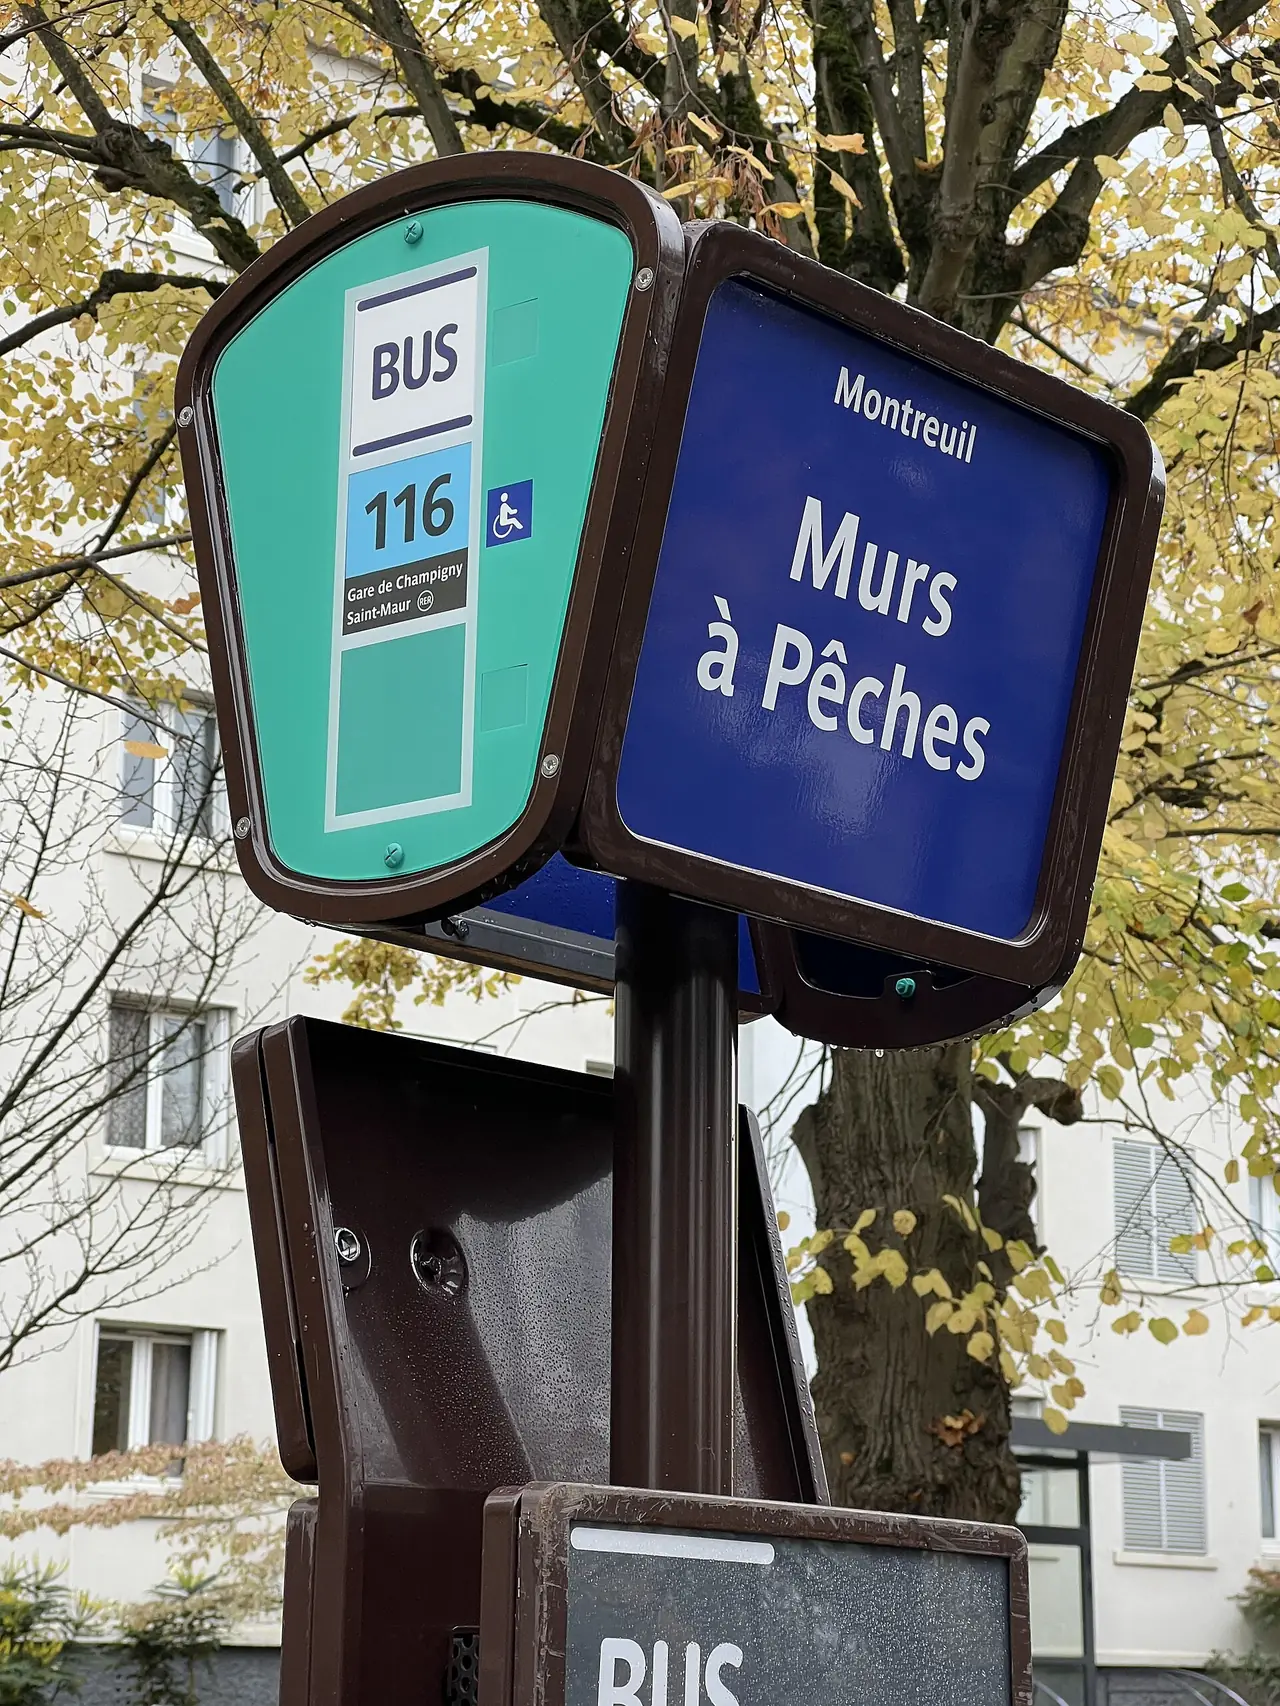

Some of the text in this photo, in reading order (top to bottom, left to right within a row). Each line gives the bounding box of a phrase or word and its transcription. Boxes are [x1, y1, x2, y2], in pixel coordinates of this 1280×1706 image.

[372, 323, 458, 400] BUS
[834, 366, 977, 463] Montreuil
[365, 473, 454, 550] 116
[347, 562, 463, 602] Gare de Champigny
[790, 496, 957, 637] Murs
[346, 599, 411, 626] Saint-Maur
[697, 595, 991, 781] à Pêches
